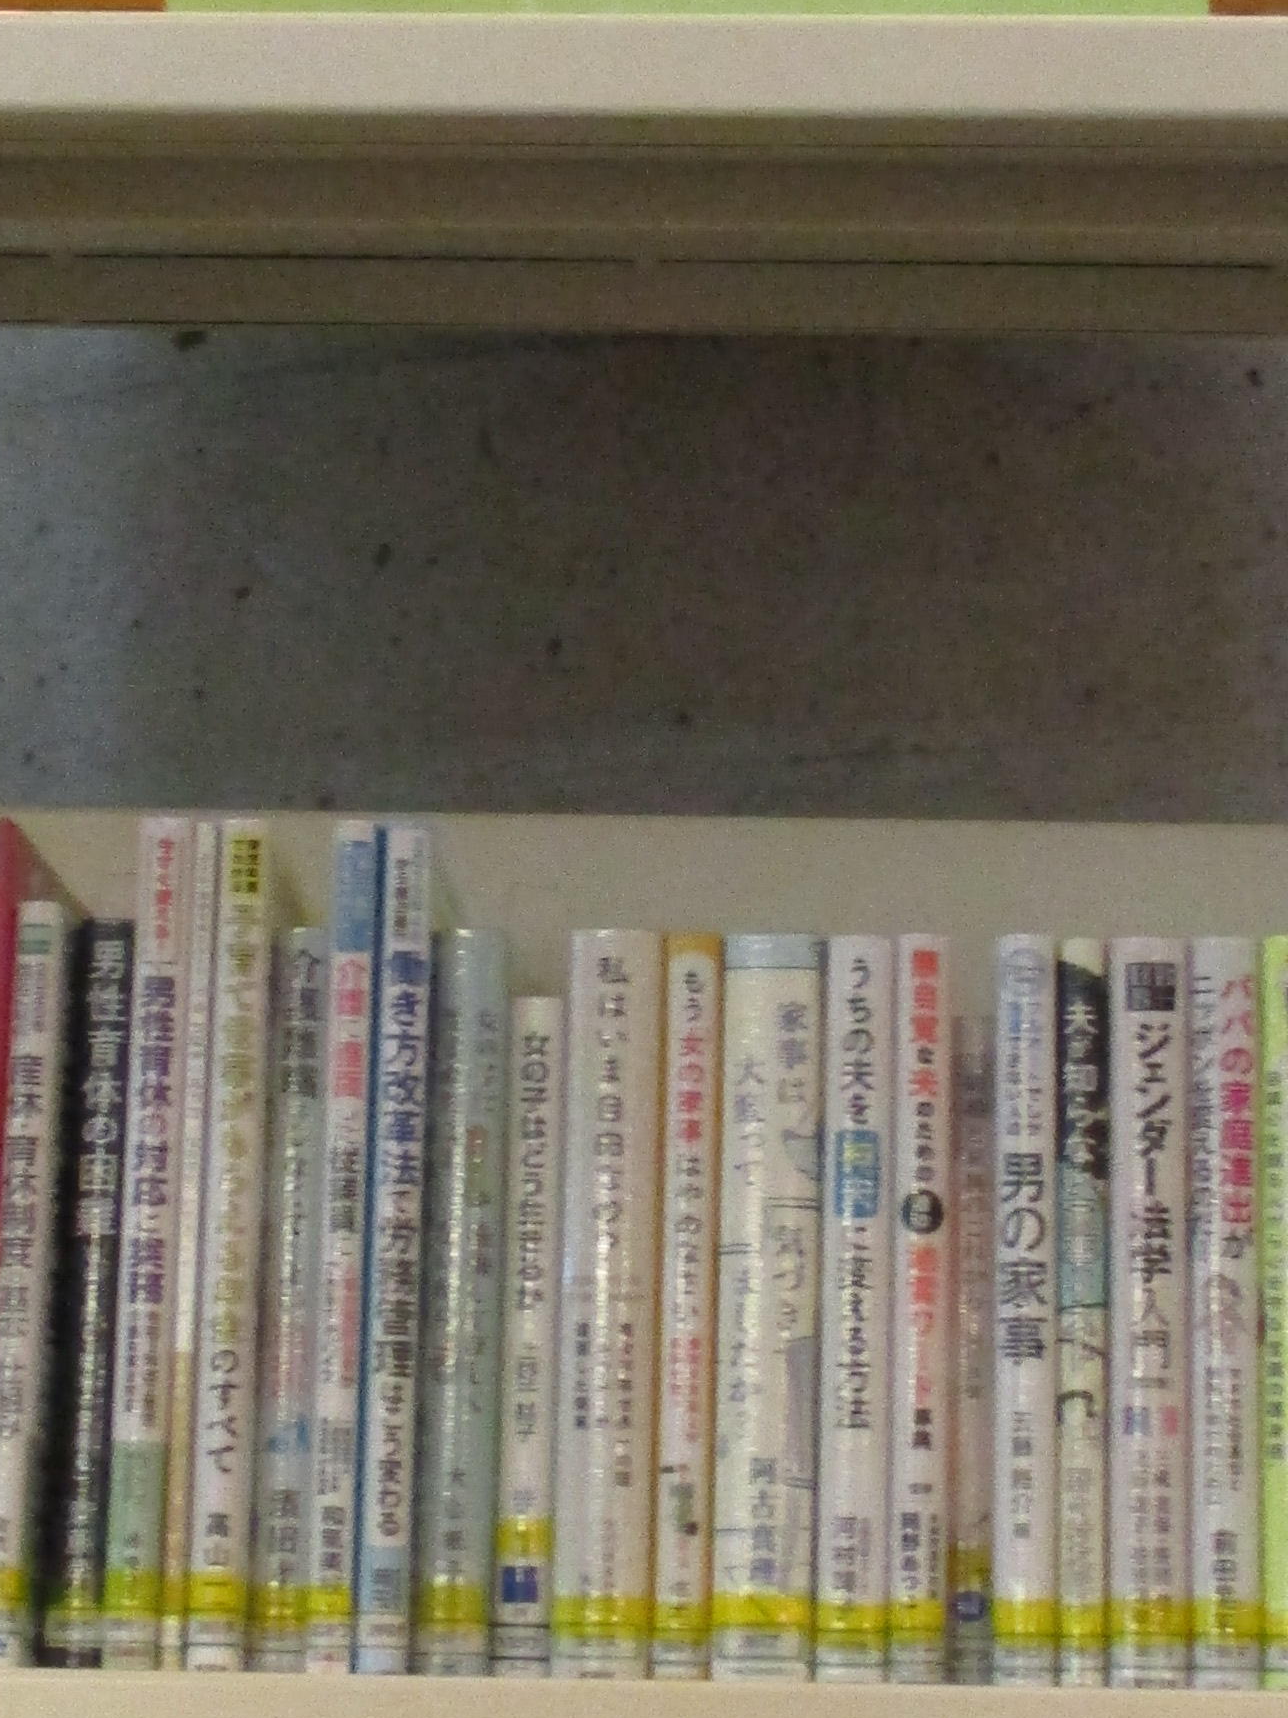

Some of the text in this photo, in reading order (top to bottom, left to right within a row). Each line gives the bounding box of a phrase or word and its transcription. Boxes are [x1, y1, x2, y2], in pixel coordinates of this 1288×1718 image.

[75, 938, 127, 1238] 男性育休の困難
[1001, 1151, 1048, 1362] 男の家事
